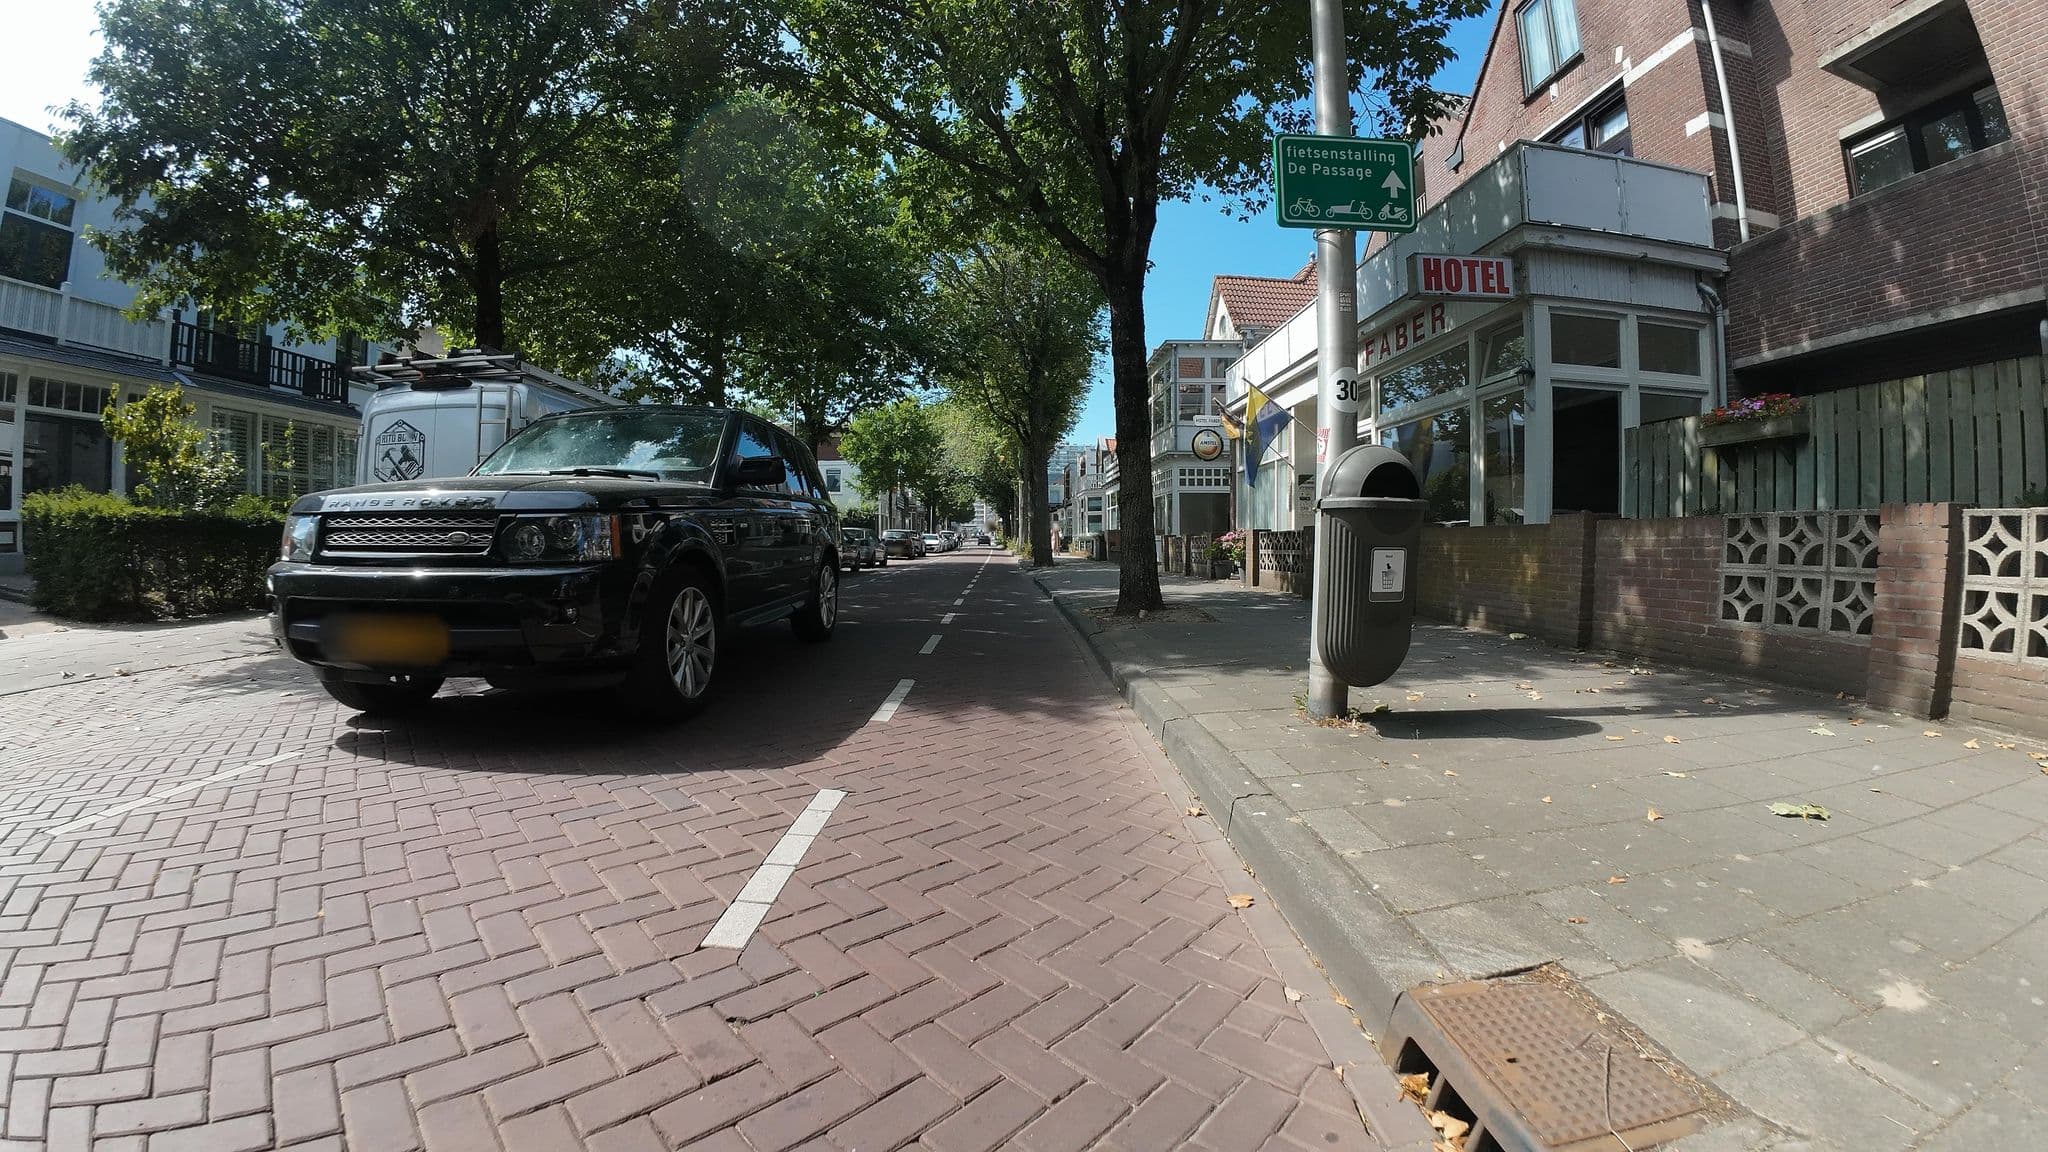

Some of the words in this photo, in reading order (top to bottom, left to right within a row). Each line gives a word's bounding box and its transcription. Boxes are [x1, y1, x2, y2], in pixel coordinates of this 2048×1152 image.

[1286, 145, 1396, 166] fietsenstalling
[1288, 162, 1307, 175] De
[1312, 163, 1373, 180] Passage
[1422, 257, 1510, 294] HOTEL
[1364, 302, 1446, 366] FABER
[1336, 380, 1358, 402] 30
[328, 499, 396, 508] RANGE
[402, 496, 494, 508] ROVER
